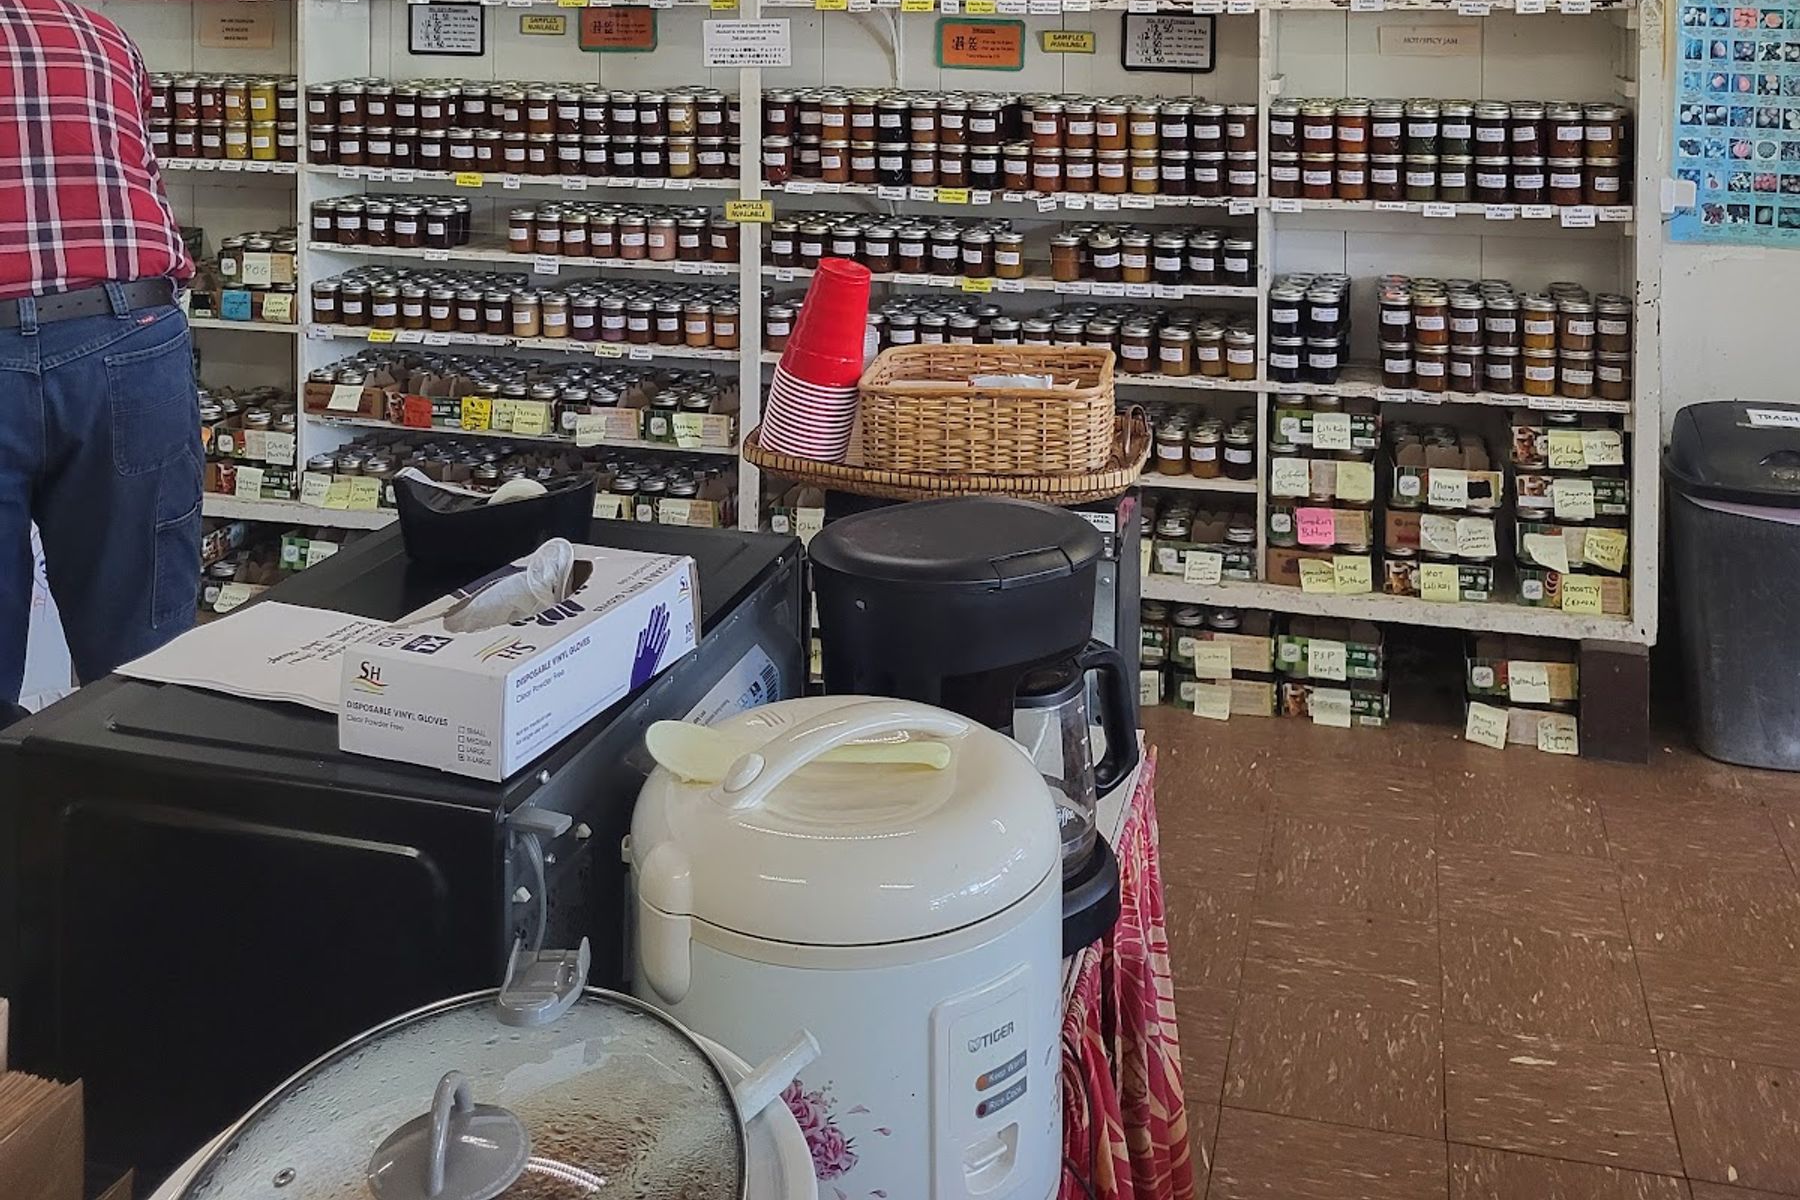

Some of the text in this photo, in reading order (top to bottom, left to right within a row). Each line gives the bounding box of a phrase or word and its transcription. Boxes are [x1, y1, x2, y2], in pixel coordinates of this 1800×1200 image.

[1757, 413, 1800, 423] TRASH
[359, 661, 381, 681] SH
[515, 636, 591, 688] DISPOSABLE VINYL GLOVES
[346, 700, 449, 727] DISPOSABLE VINYL GLOVES
[346, 713, 405, 732] Clear Powder Free
[982, 1021, 1014, 1048] TIGER
